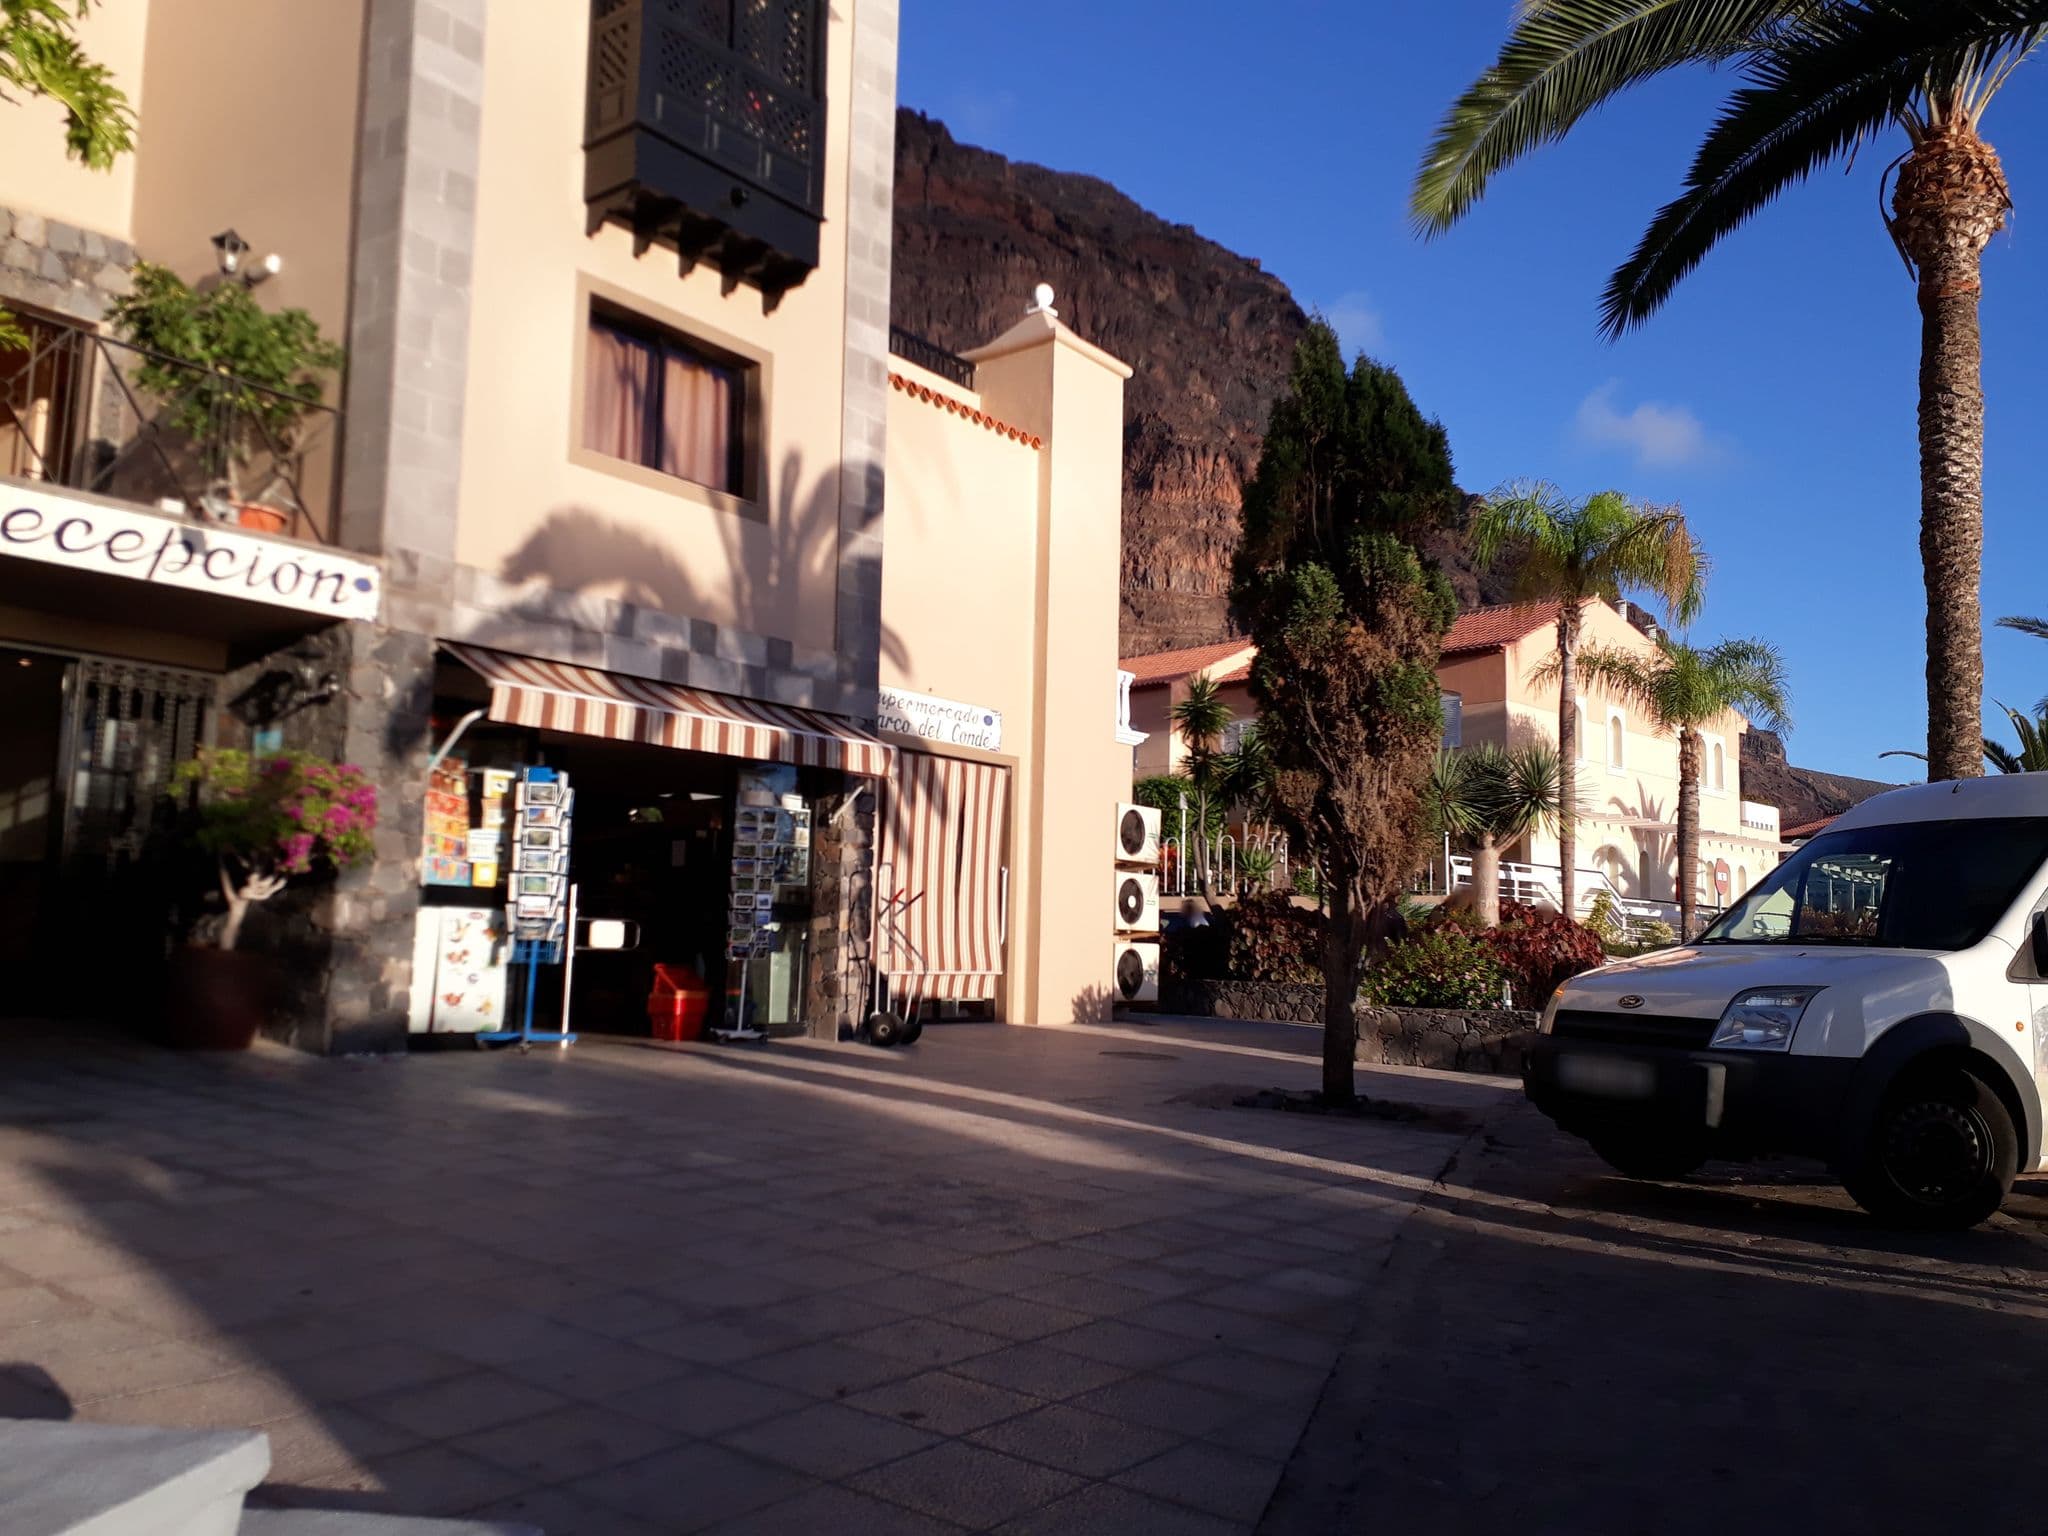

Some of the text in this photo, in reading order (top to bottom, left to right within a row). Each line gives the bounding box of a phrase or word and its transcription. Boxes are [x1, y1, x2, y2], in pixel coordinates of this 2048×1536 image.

[0, 507, 350, 603] ecepción
[918, 717, 942, 740] del
[951, 723, 991, 748] Conde
